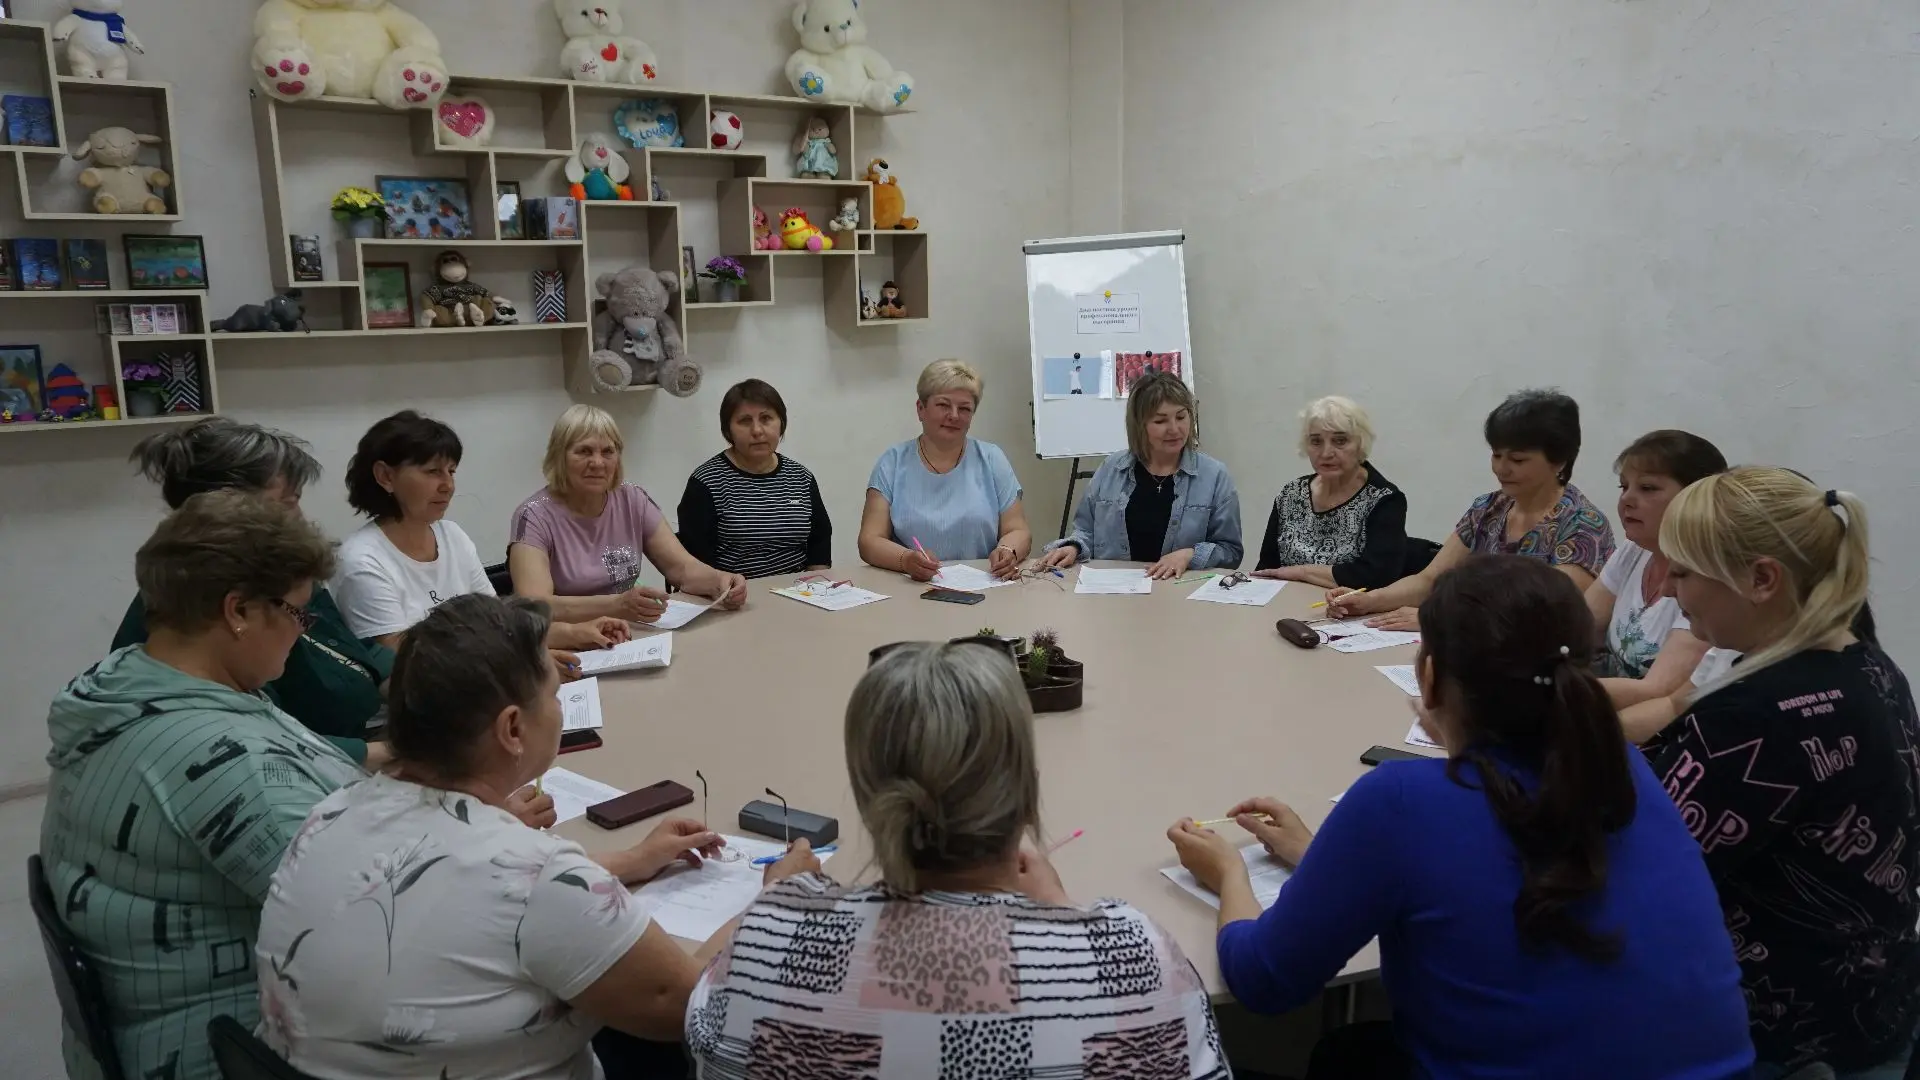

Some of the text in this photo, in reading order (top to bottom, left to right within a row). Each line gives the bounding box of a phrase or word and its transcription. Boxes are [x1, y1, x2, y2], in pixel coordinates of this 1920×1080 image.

[1777, 694, 1818, 711] BOREDOM
[1818, 692, 1828, 702] IN
[1801, 707, 1813, 717] SO
